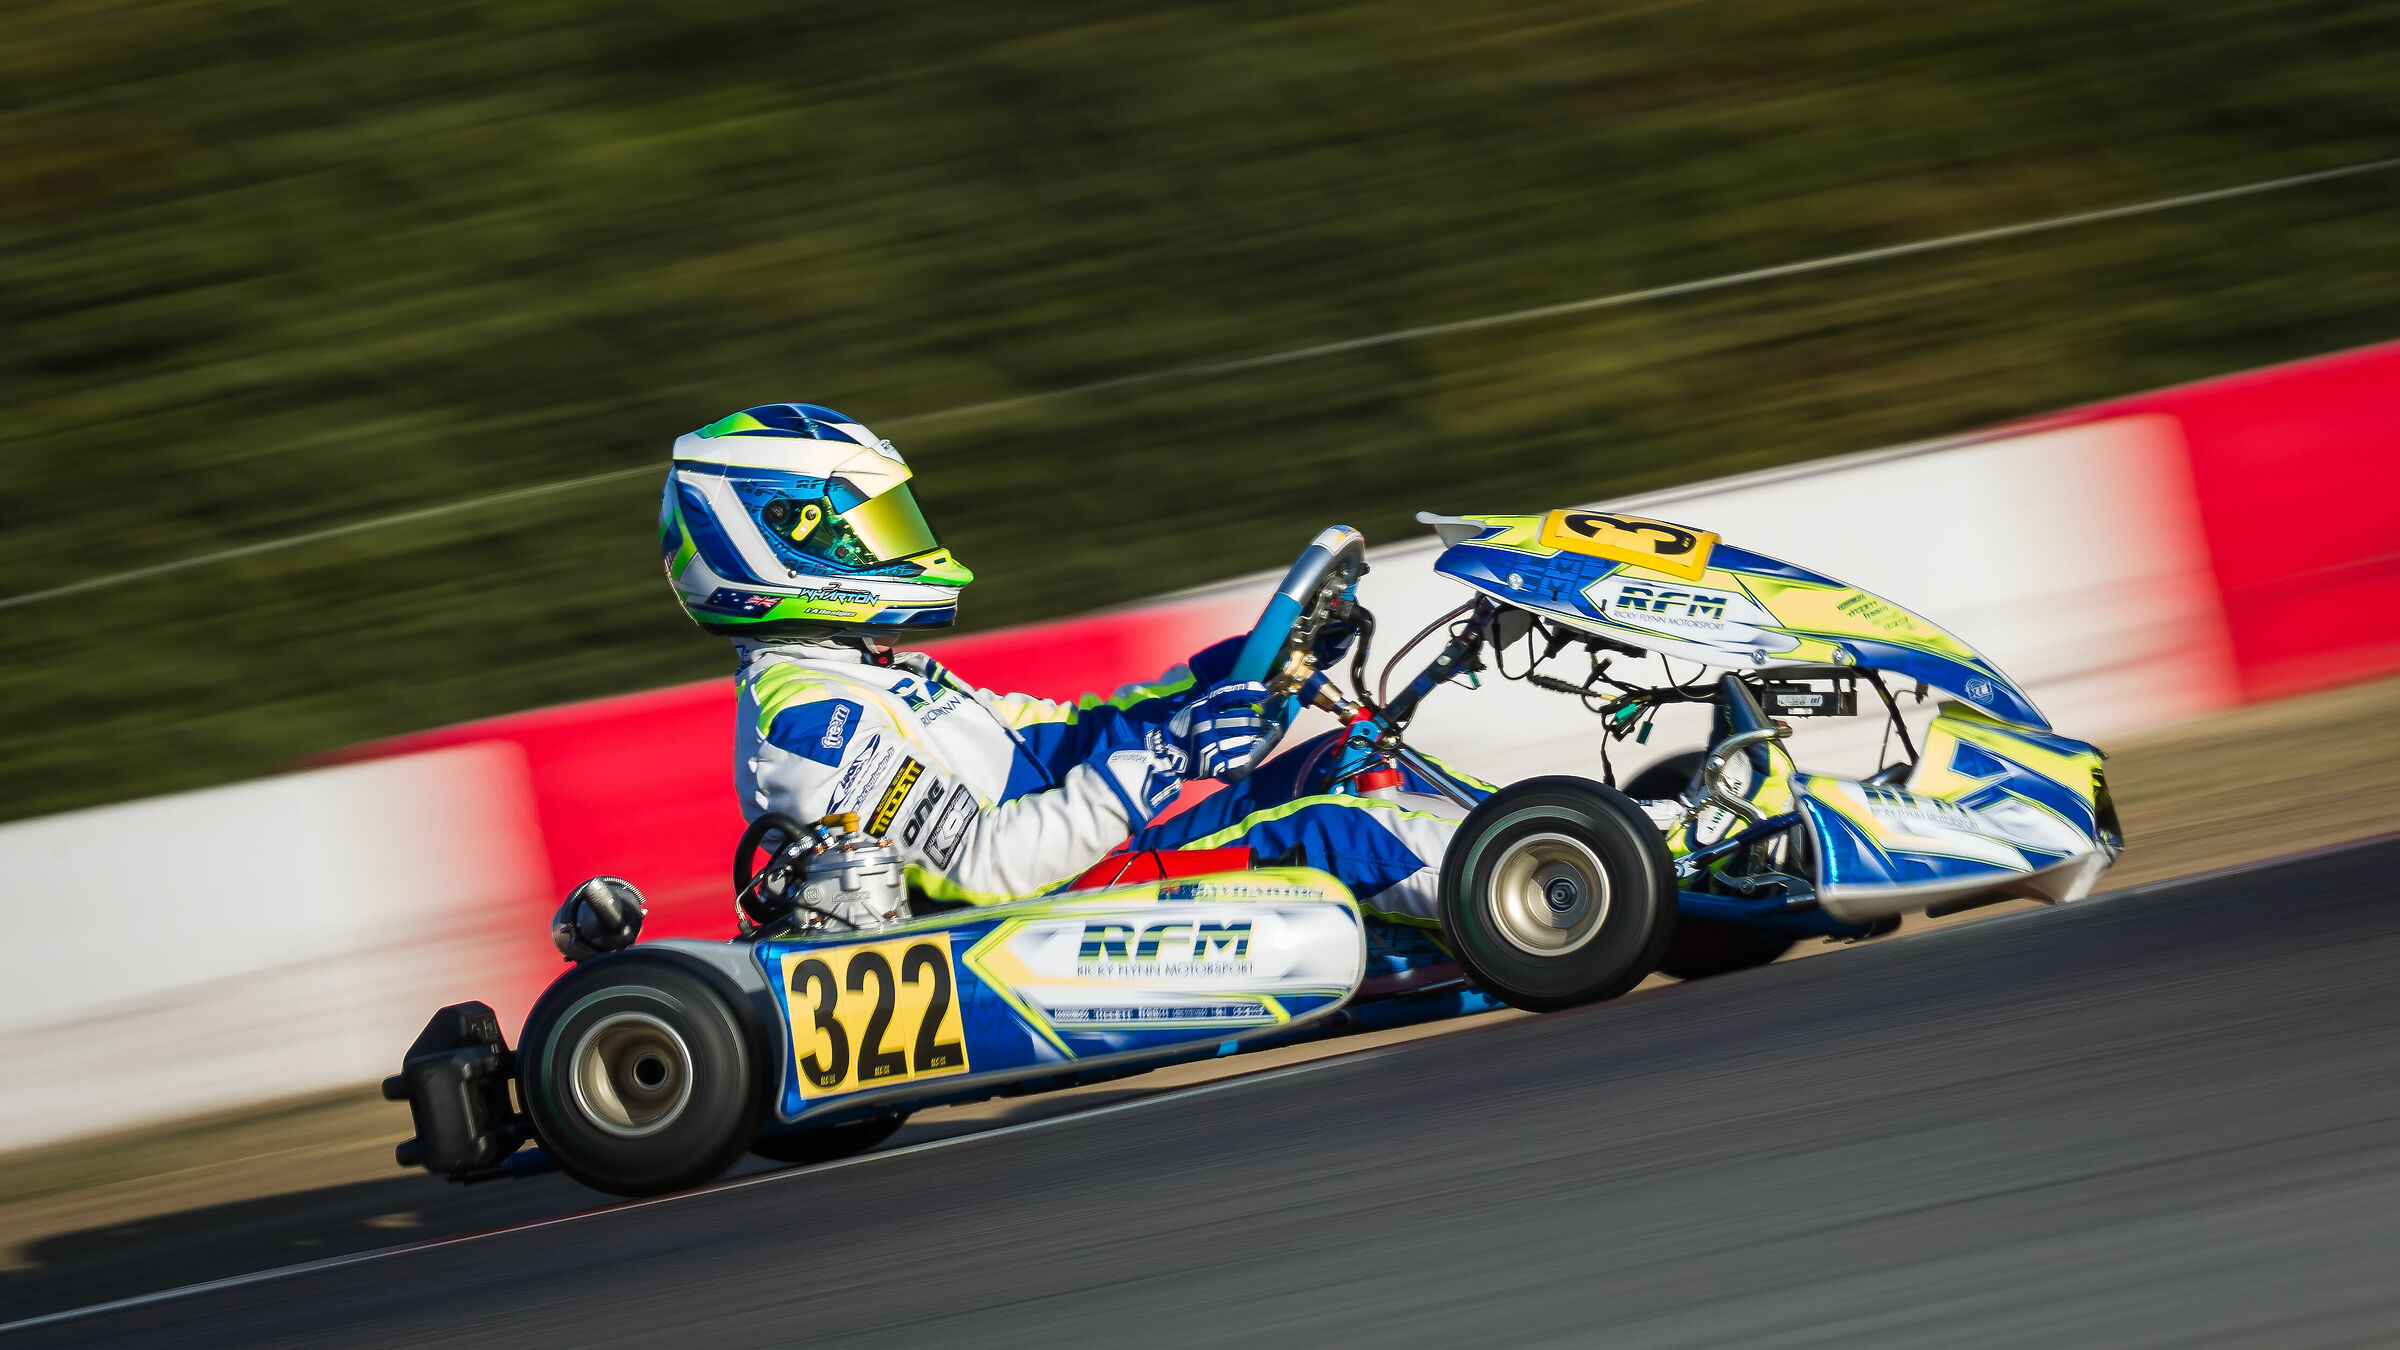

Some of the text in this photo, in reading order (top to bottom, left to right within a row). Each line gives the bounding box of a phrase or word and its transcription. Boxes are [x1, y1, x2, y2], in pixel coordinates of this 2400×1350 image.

[798, 588, 880, 607] WHARTON
[1616, 586, 1727, 620] RFM
[1614, 610, 1725, 630] RICKY FLYNN MOTORSPORT
[822, 704, 850, 749] freem
[1078, 920, 1254, 961] RFM
[1077, 960, 1254, 977] RICKY FLYNN MOTORSPORT
[791, 944, 965, 1088] 322
